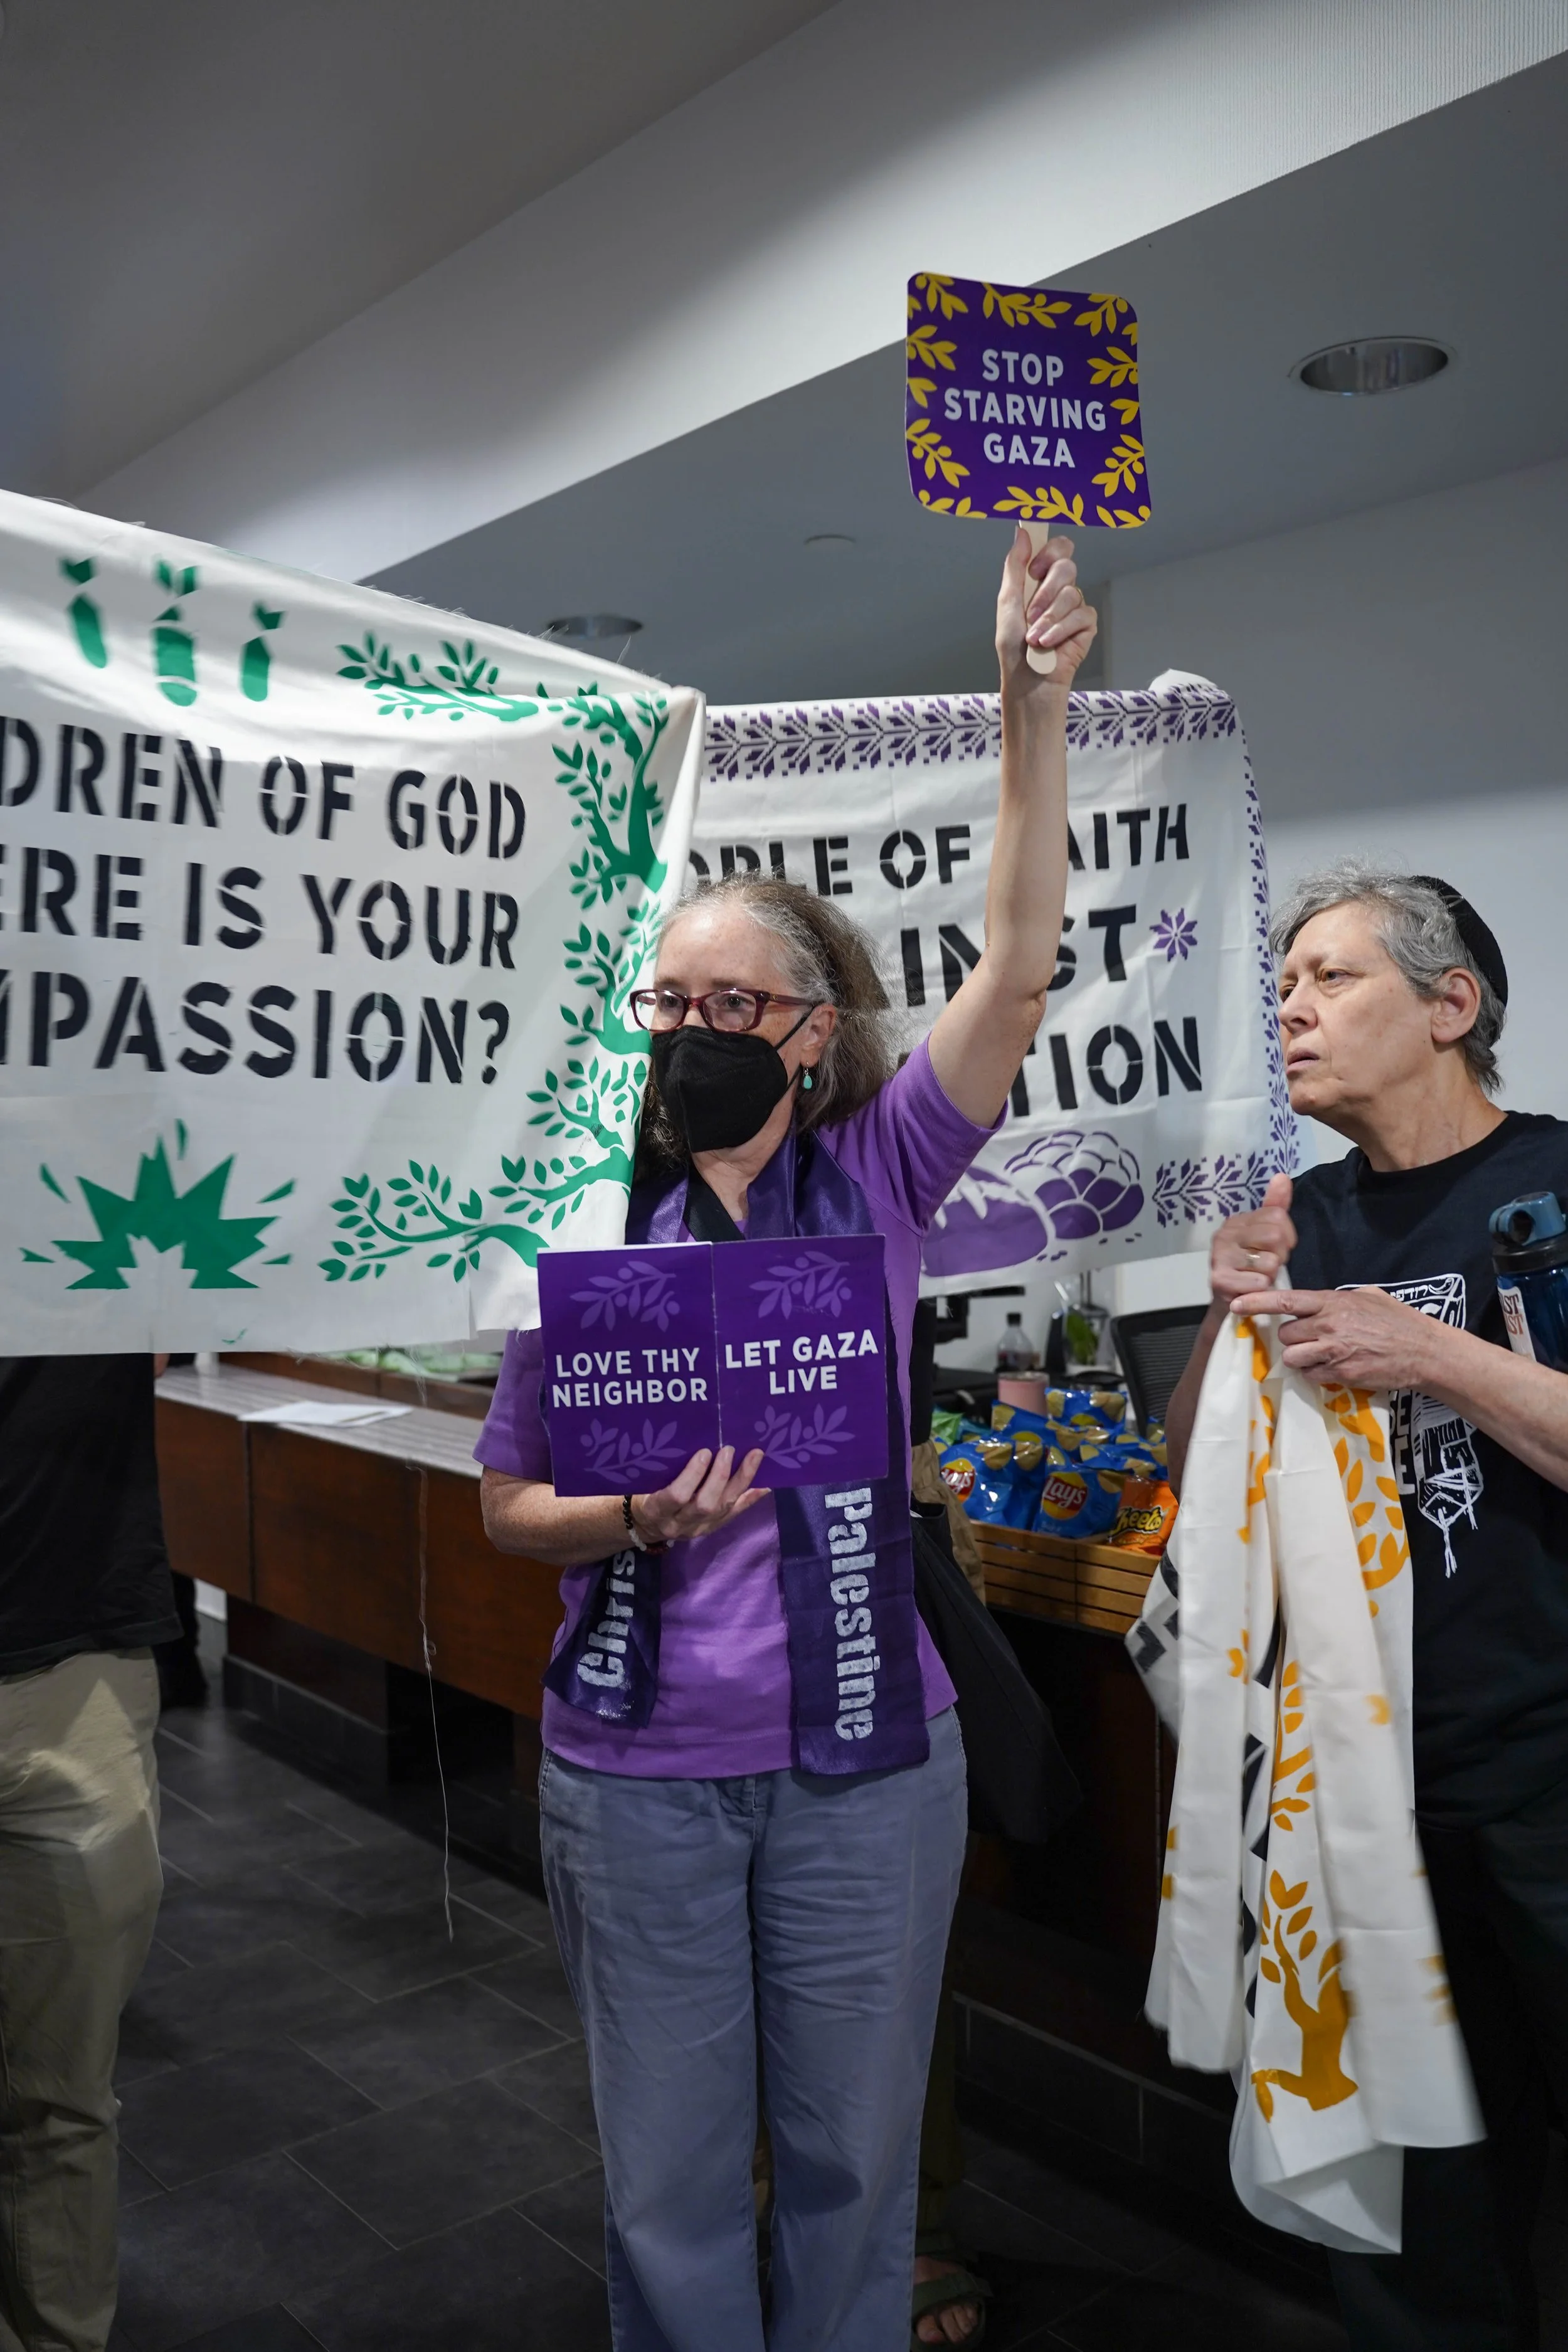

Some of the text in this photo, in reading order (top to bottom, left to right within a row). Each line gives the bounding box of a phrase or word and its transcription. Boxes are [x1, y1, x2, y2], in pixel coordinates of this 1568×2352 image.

[982, 349, 1064, 386] STOP
[944, 388, 1106, 432] STARVING
[983, 433, 1076, 468] GAZA
[259, 755, 355, 840] OF
[387, 770, 526, 859] GOD
[879, 825, 972, 890] OF
[0, 844, 519, 970] RE IS YOUR
[556, 1347, 700, 1378] LOVE THY
[725, 1329, 879, 1369] LET GAZA
[552, 1378, 708, 1408] NEIGHBOR
[770, 1365, 838, 1396] LIVE
[576, 1550, 635, 1688] Chris
[824, 1487, 881, 1741] Palestine
